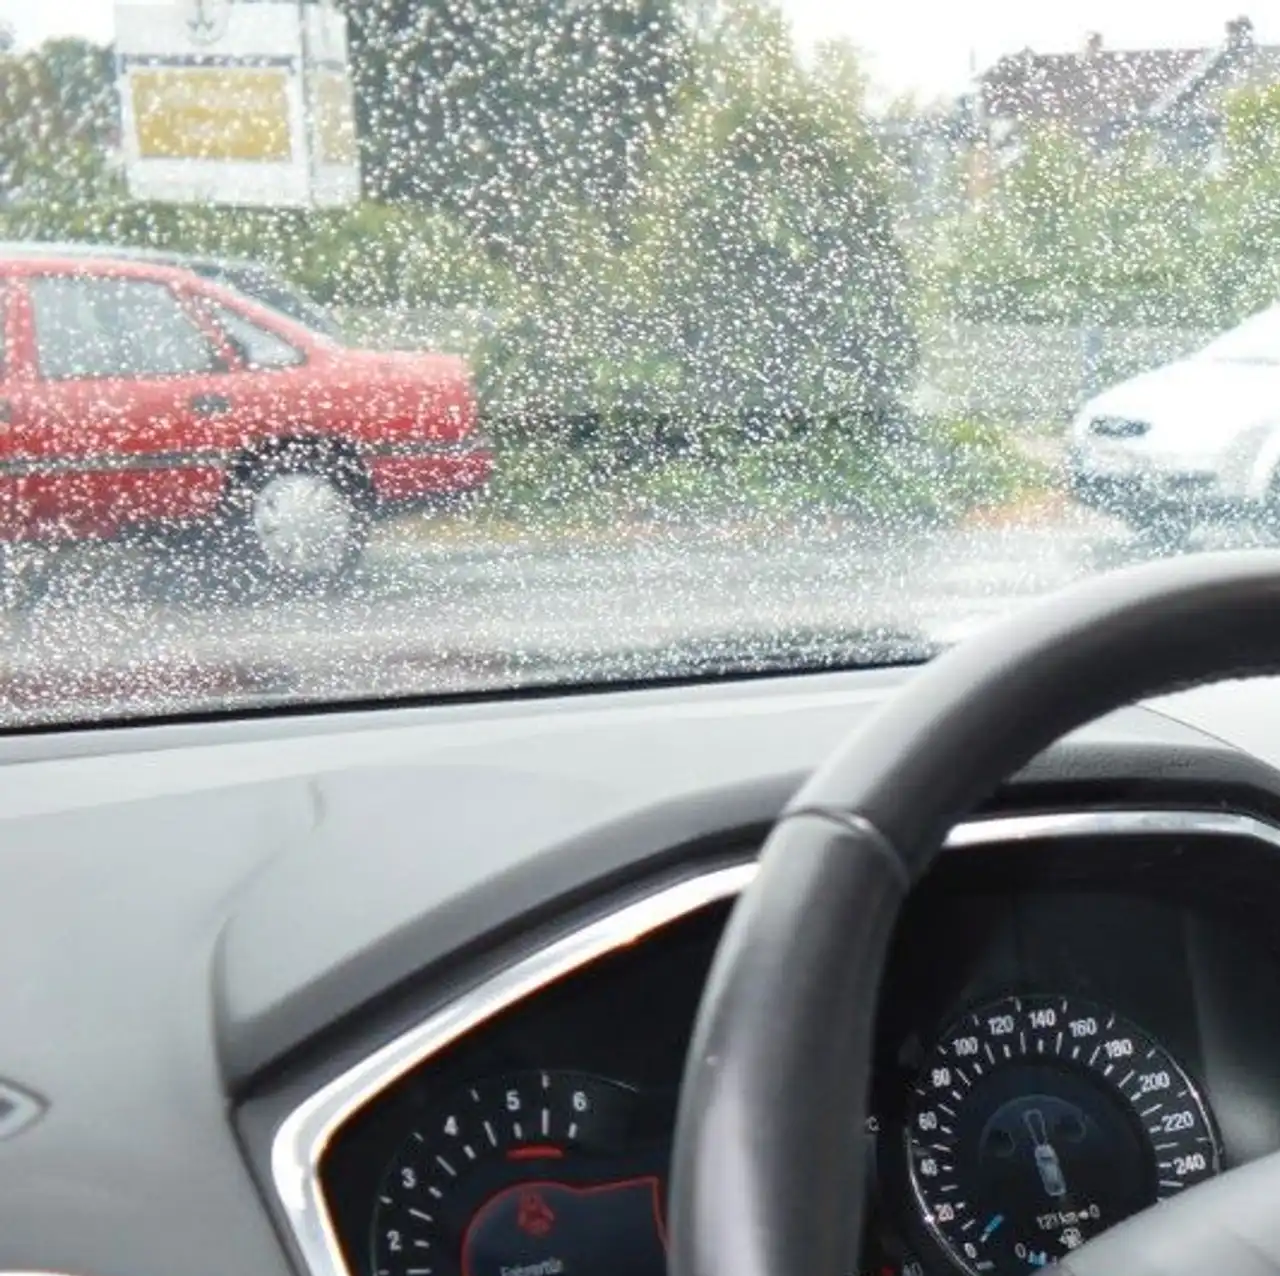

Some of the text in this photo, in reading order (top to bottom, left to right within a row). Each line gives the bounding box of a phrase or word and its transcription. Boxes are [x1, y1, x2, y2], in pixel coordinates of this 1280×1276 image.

[987, 1014, 1015, 1036] 120
[1028, 1007, 1057, 1028] 140
[1068, 1016, 1097, 1037] 160
[953, 1036, 979, 1057] 100
[1104, 1038, 1134, 1059] 180
[931, 1067, 951, 1088] 80
[1139, 1070, 1171, 1094] 200
[506, 1090, 521, 1111] 5
[573, 1091, 588, 1112] 6
[443, 1115, 459, 1136] 4
[918, 1110, 938, 1131] 60
[1161, 1109, 1195, 1134] 220
[920, 1157, 938, 1178] 40
[1171, 1152, 1207, 1176] 240
[401, 1167, 417, 1190] 3
[387, 1229, 401, 1252] 2
[964, 1242, 977, 1259] 0
